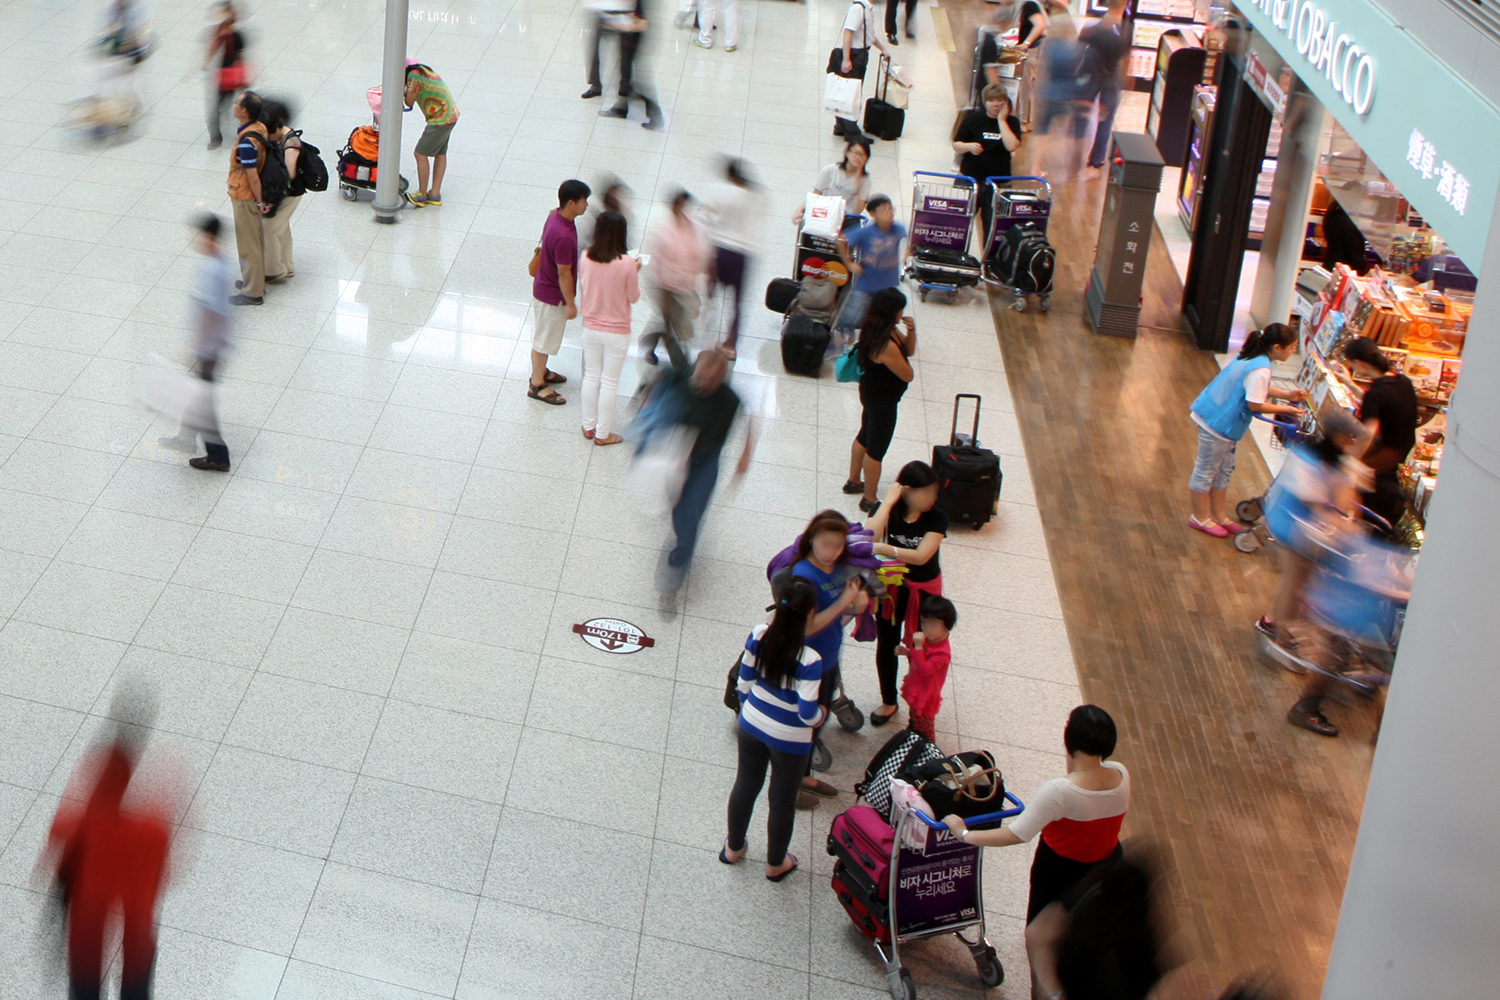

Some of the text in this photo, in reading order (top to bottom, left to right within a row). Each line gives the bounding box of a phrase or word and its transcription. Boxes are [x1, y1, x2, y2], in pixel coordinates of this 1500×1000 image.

[928, 200, 947, 208] VISA
[914, 228, 964, 240] 비자 시그니처로
[1122, 221, 1140, 274] 소화전
[801, 264, 848, 280] MasterCard
[587, 627, 622, 641] 170m
[935, 829, 955, 842] VIS
[900, 875, 921, 889] 비자
[922, 865, 972, 884] 시그니처로
[915, 881, 956, 899] 누리세요
[960, 907, 976, 917] VISA
